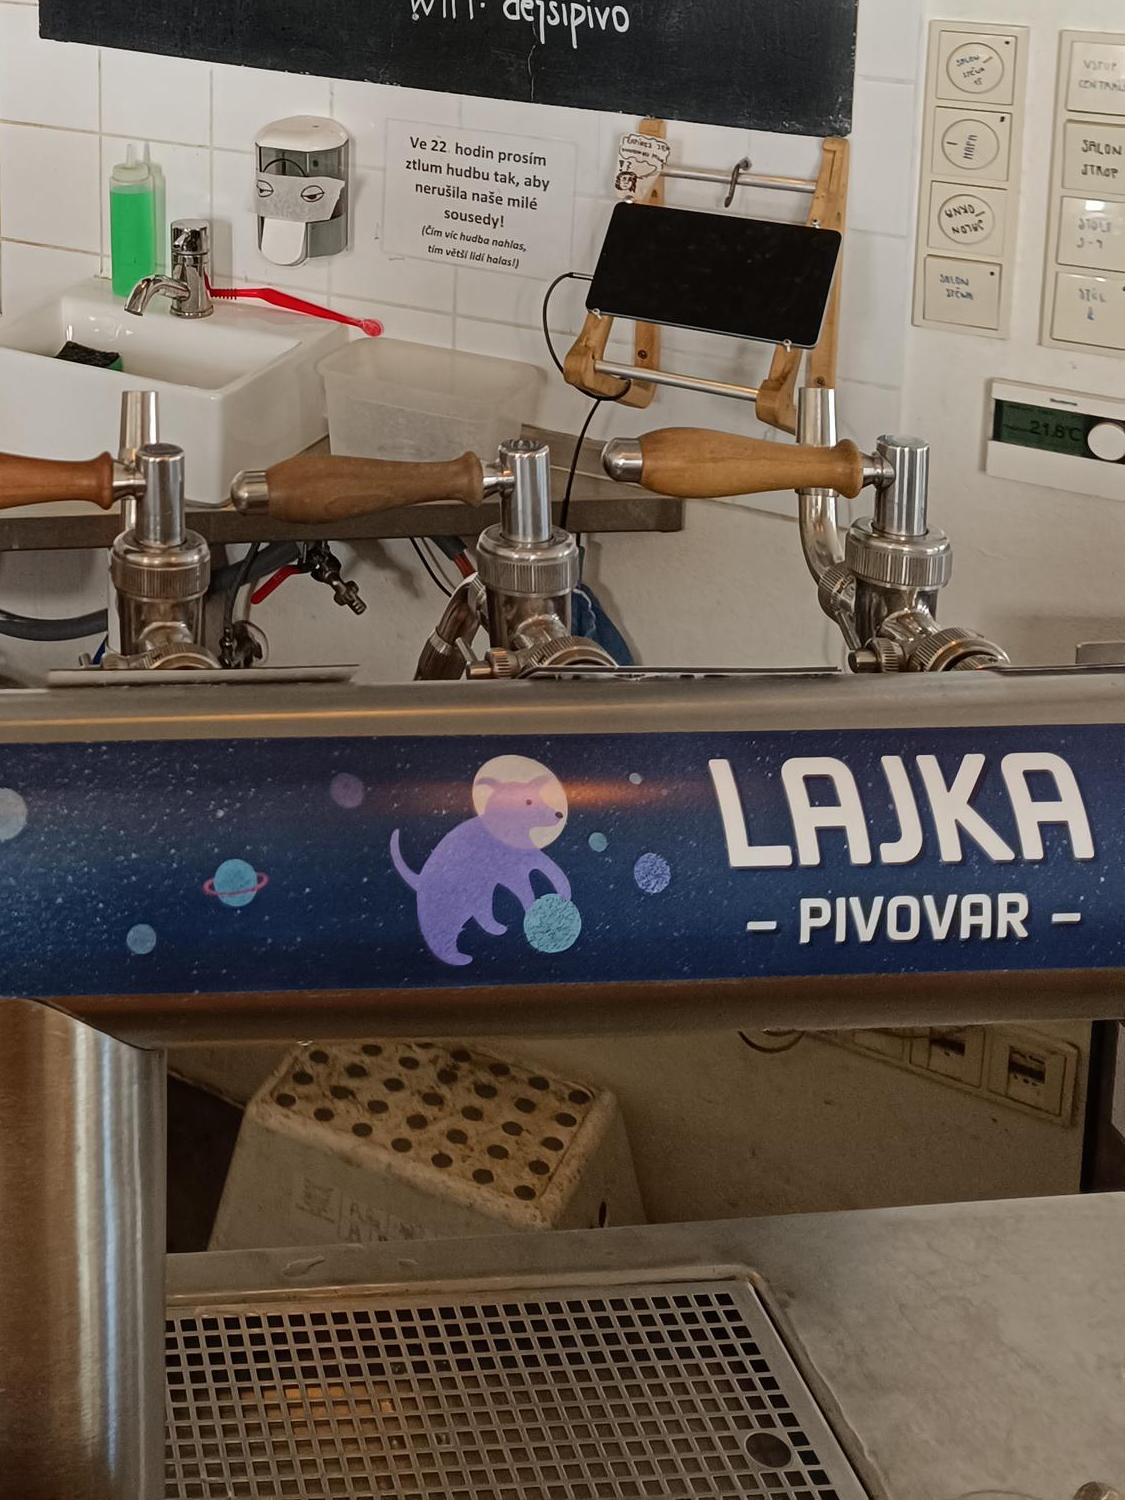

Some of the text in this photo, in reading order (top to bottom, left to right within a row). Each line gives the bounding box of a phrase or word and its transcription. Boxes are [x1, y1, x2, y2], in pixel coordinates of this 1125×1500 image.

[410, 136, 547, 167] Ve 22 hodin prosím
[405, 159, 550, 192] ztlum hudbu tak, aby
[415, 182, 538, 211] nerušila naše milé
[444, 208, 505, 228] sousedy!
[421, 224, 527, 252] (Čím víc hudba nahlas,
[428, 245, 444, 256] tím
[445, 247, 469, 260] větší
[469, 251, 485, 262] lidí
[707, 751, 1095, 869] LAJKA
[798, 892, 1030, 944] PIVOVAR
